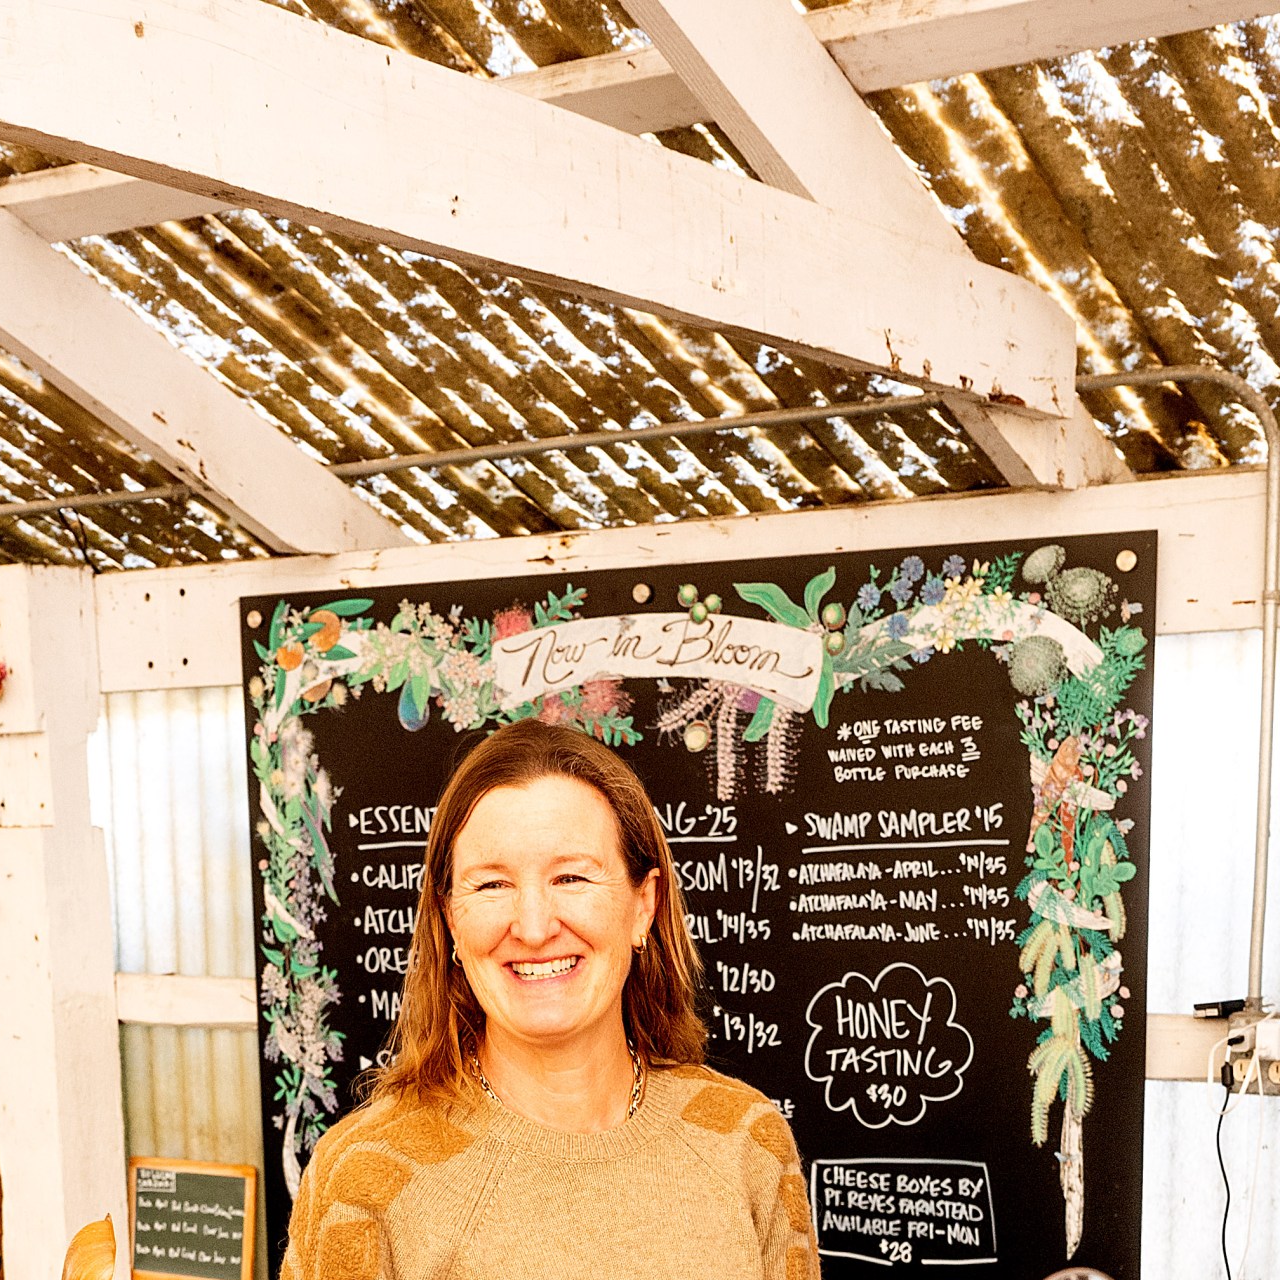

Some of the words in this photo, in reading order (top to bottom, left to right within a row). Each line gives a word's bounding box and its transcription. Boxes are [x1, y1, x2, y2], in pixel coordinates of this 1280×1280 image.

[501, 629, 607, 687] Now
[608, 628, 661, 660] in
[657, 617, 813, 677] Bloom
[883, 717, 947, 735] TASTING
[951, 715, 983, 731] FEE
[881, 743, 915, 760] WITH
[919, 740, 954, 757] EACH
[960, 736, 978, 753] 3
[834, 766, 886, 783] BOTTLE
[894, 763, 970, 780] PURCHASE
[804, 811, 872, 841] SWAMP
[877, 808, 972, 838] SAMPLER
[835, 991, 933, 1045] HONEY
[826, 1045, 953, 1079] TASTING
[866, 1083, 907, 1109] $30
[822, 1165, 891, 1192] CHEESE
[896, 1174, 954, 1197] BOXES
[958, 1177, 984, 1199] BY
[824, 1187, 845, 1207] PT.
[847, 1192, 896, 1214] REYES
[899, 1198, 984, 1222] FARMSTEAD
[822, 1210, 902, 1237] AVAILABLE
[907, 1221, 980, 1247] FRI-MON
[879, 1238, 913, 1263] $28
